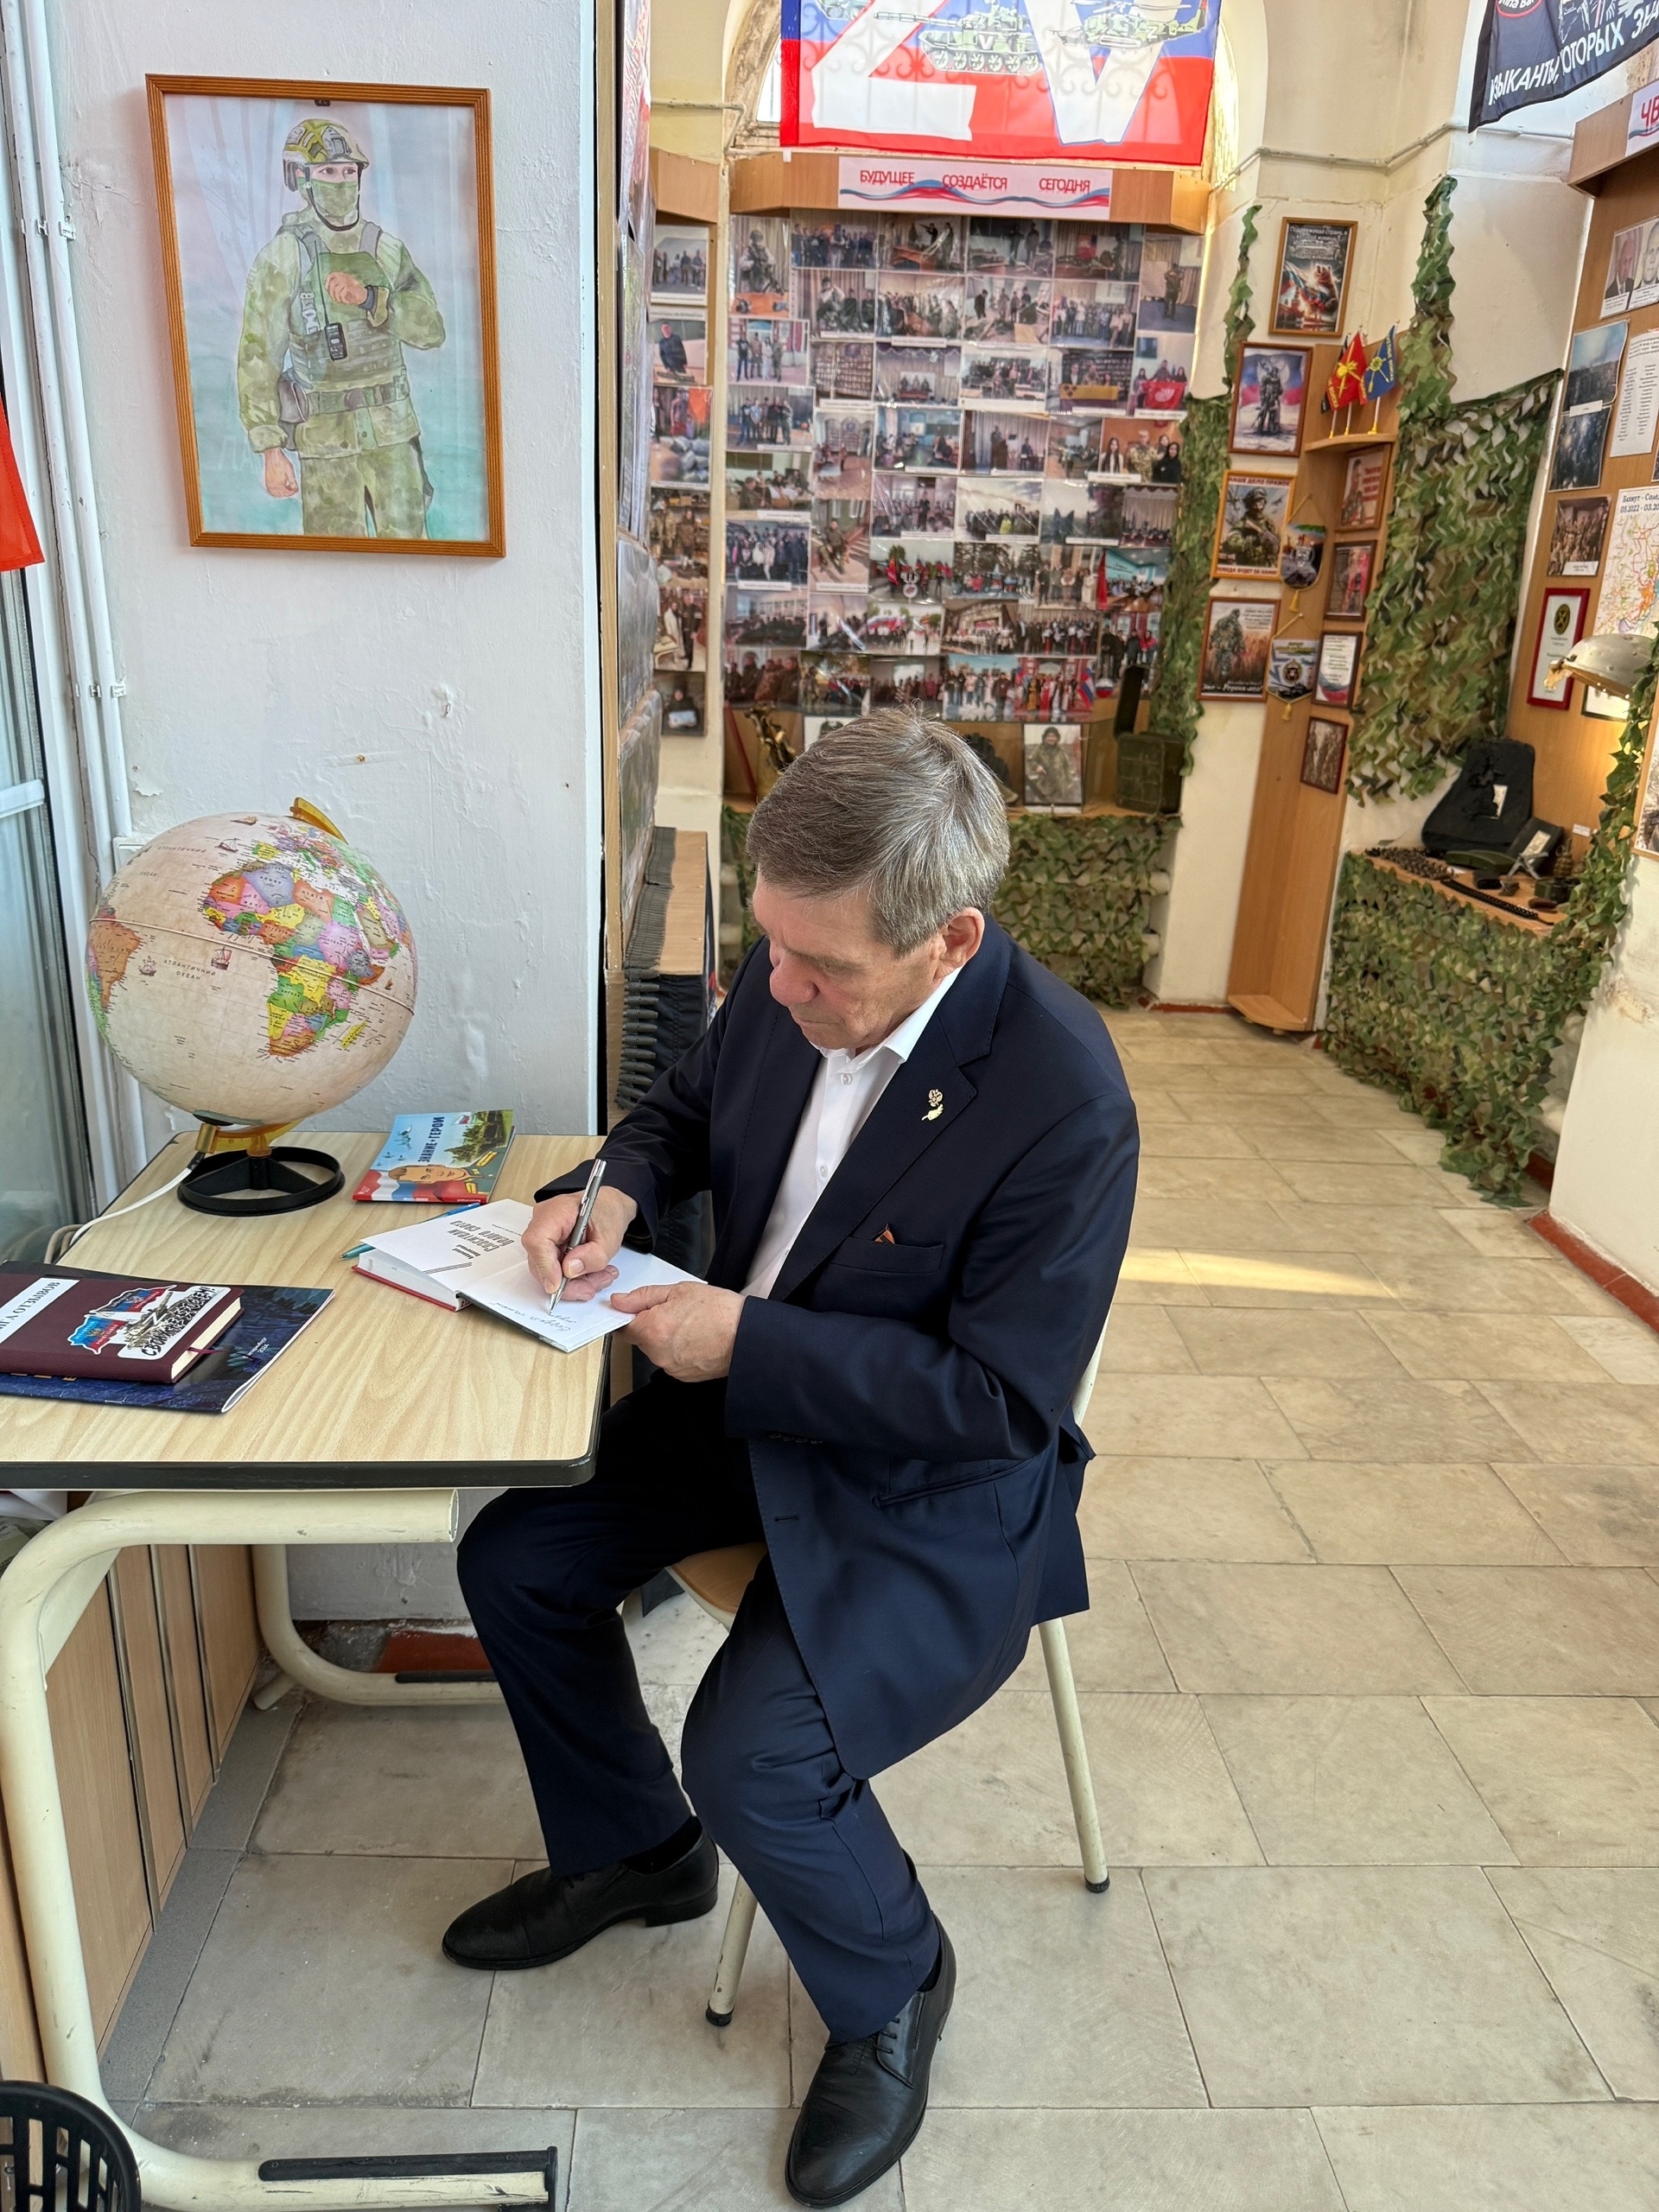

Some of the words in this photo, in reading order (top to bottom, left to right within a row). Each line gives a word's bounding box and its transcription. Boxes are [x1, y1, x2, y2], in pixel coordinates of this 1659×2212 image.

[1560, 16, 1624, 76] ОТОРЫХ
[860, 170, 914, 185] БУДУЩЕЕ
[942, 174, 1007, 189] СОЗДАЁТСЯ
[1039, 178, 1090, 194] СЕГОДНЯ
[176, 970, 200, 980] ОКЕАН
[428, 1116, 445, 1139] ГЕРОИ
[13, 1282, 60, 1314] ОТЗЫВОВ
